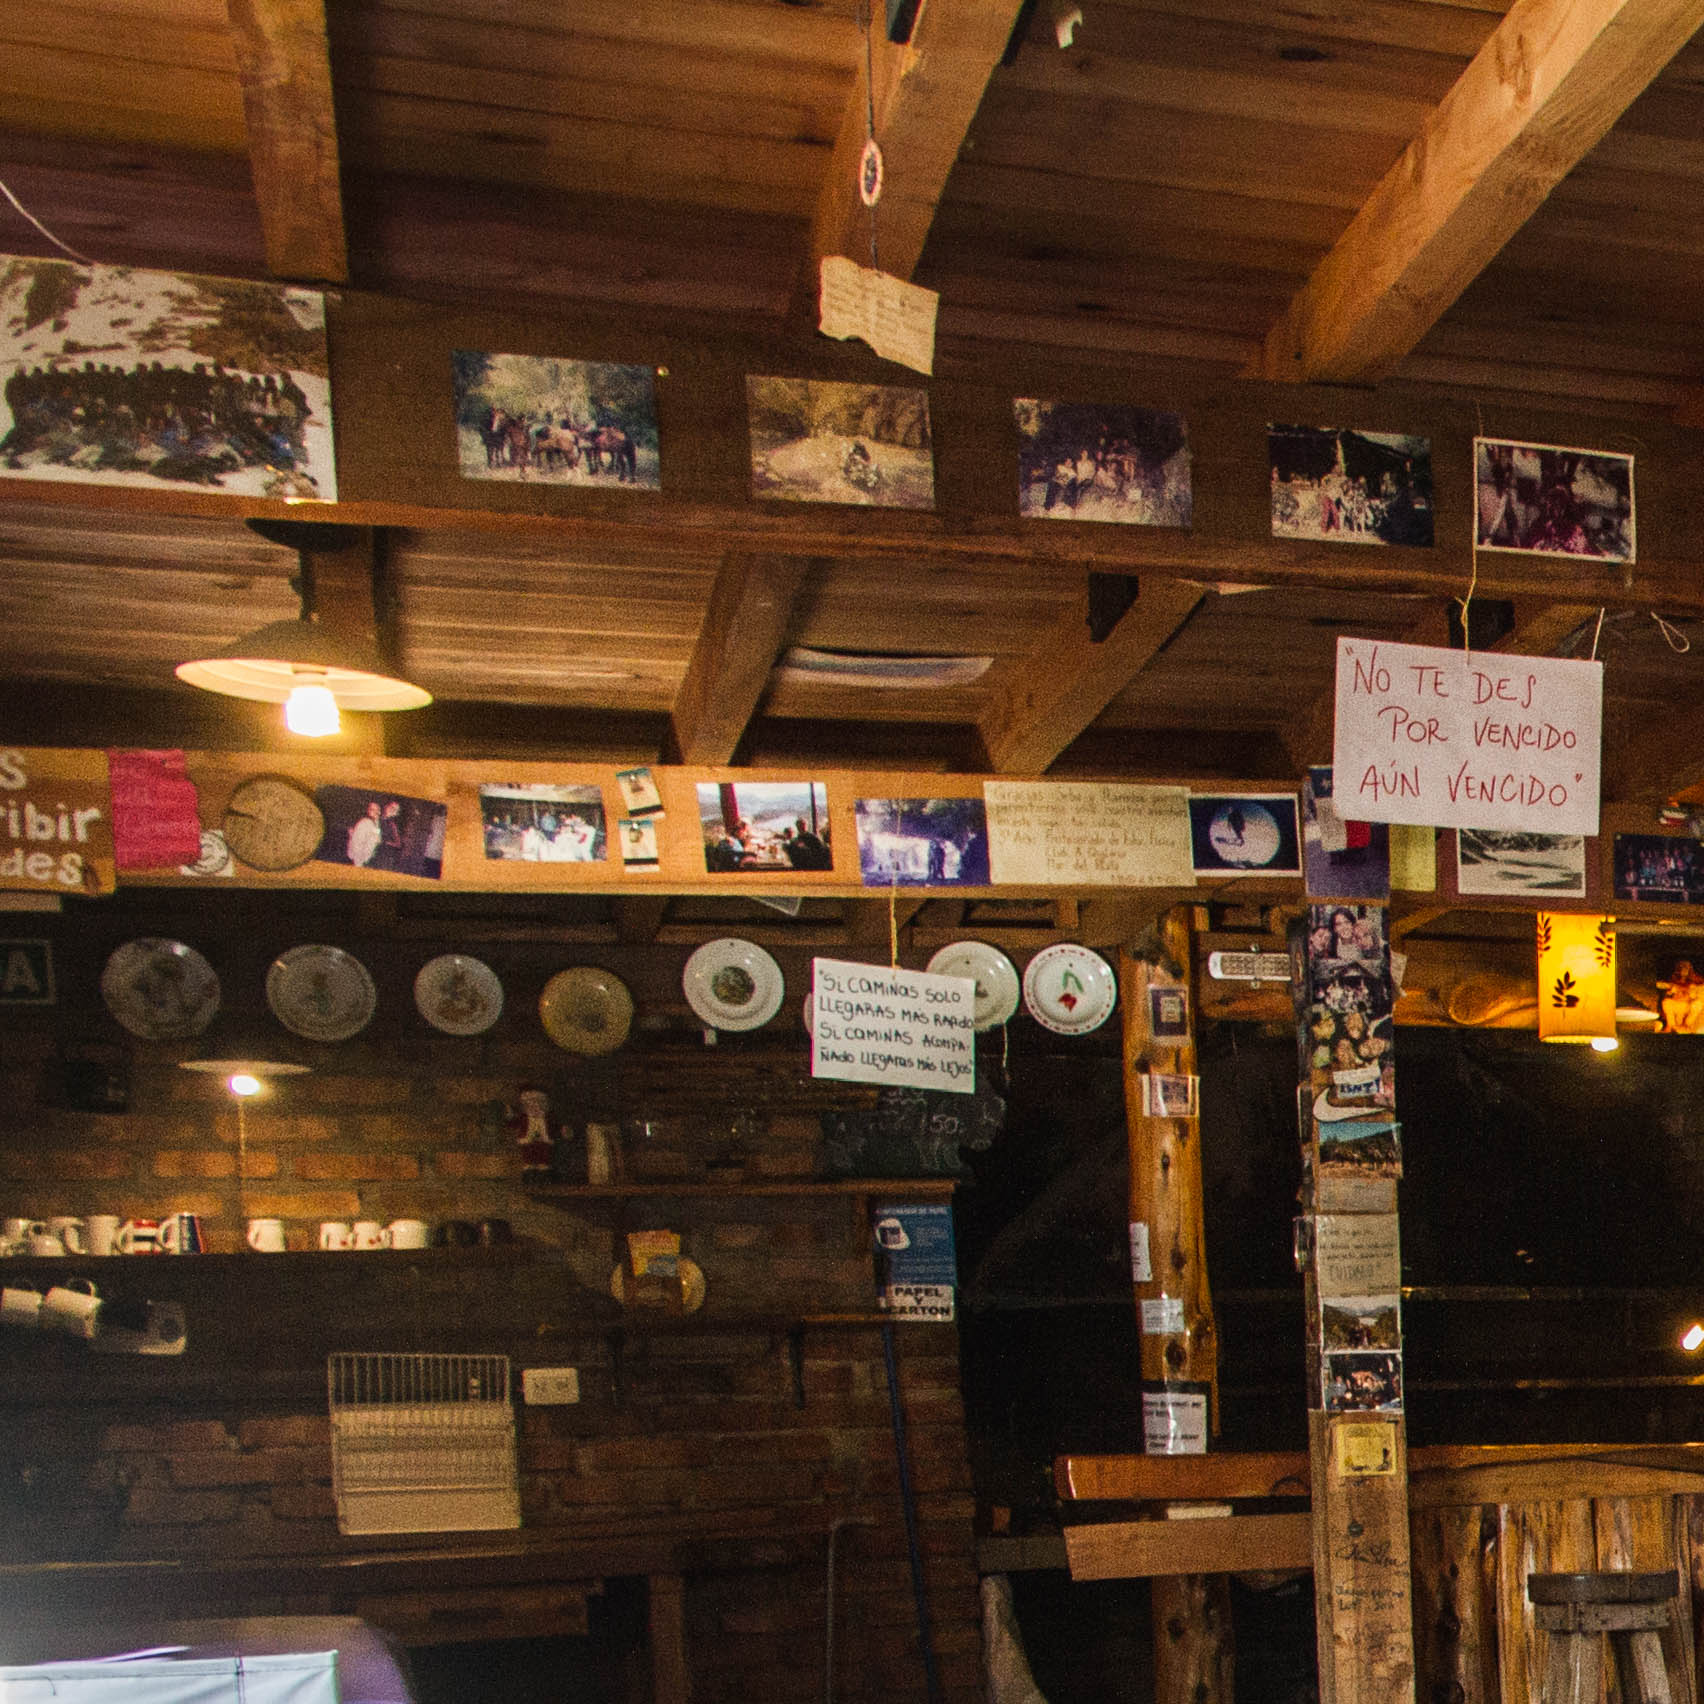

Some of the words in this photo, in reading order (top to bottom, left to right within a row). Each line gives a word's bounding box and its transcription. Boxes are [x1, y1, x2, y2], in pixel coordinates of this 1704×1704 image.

[1410, 665, 1449, 698] TE
[1472, 672, 1537, 709] DES
[1377, 705, 1449, 745] POR
[1473, 716, 1577, 751] VENCIDO
[1359, 759, 1420, 803] AÚN
[894, 1286, 943, 1297] PAPEL
[914, 1296, 925, 1306] Y
